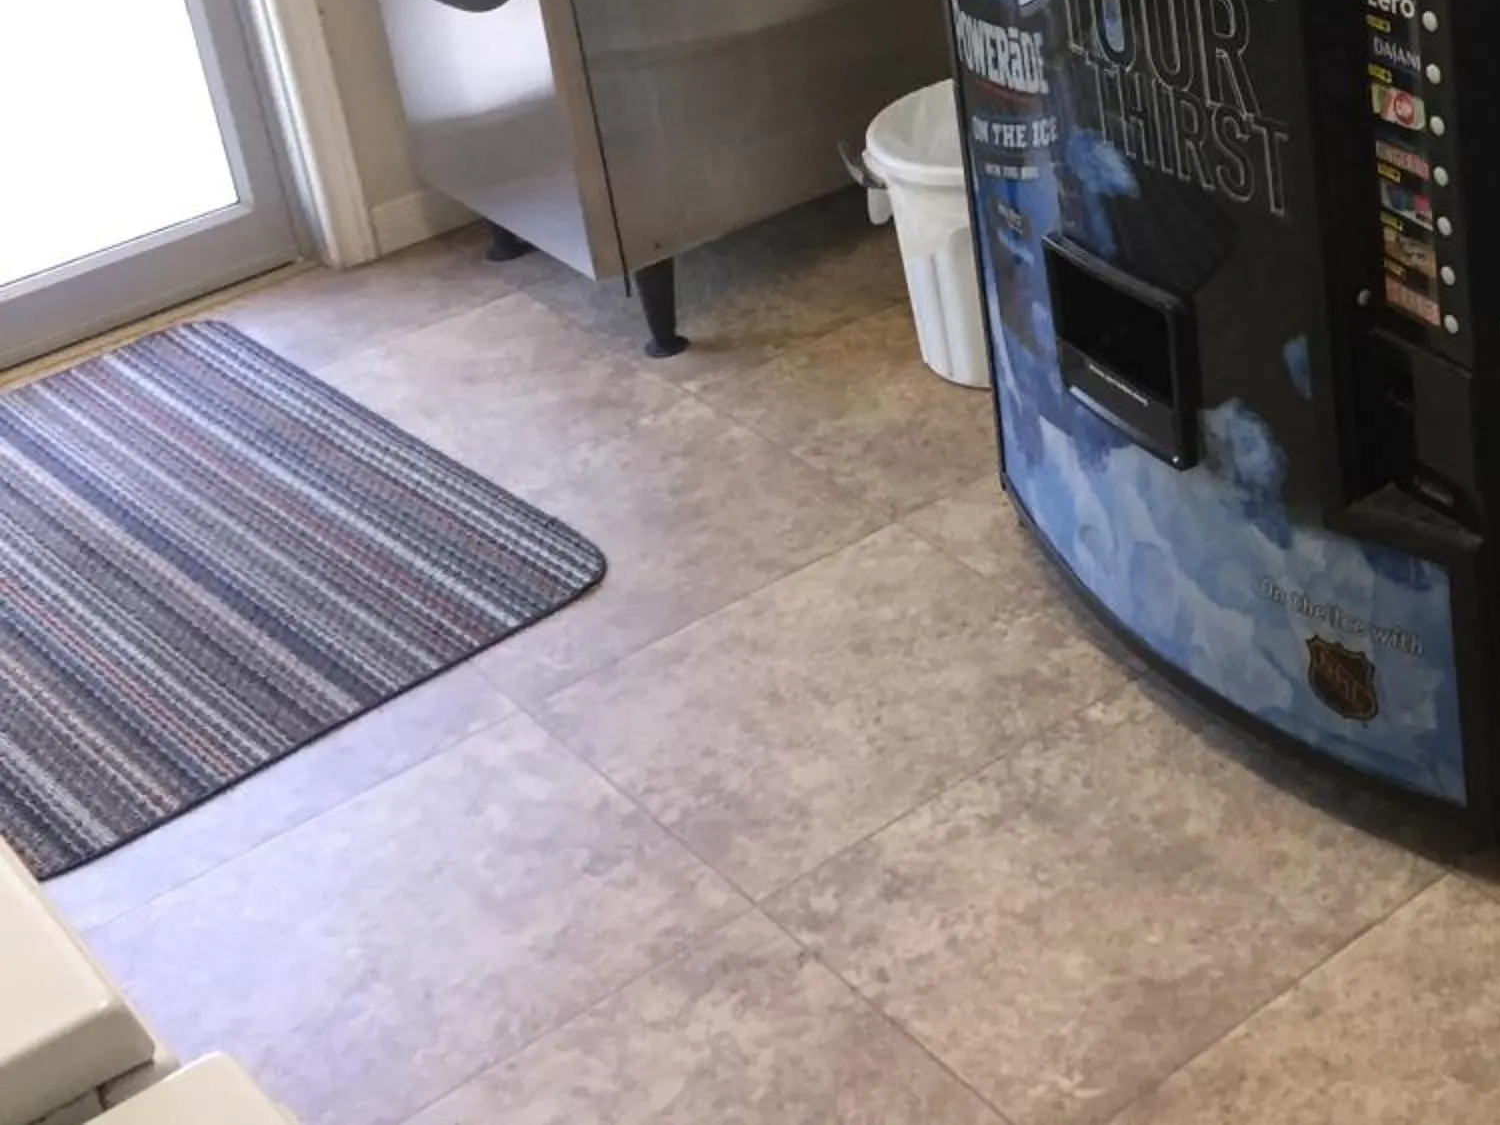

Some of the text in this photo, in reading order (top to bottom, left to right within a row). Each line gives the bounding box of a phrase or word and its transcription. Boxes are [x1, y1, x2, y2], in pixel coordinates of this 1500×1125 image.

[991, 124, 1028, 149] THE
[1085, 59, 1290, 217] THIRST
[1371, 625, 1424, 656] with
